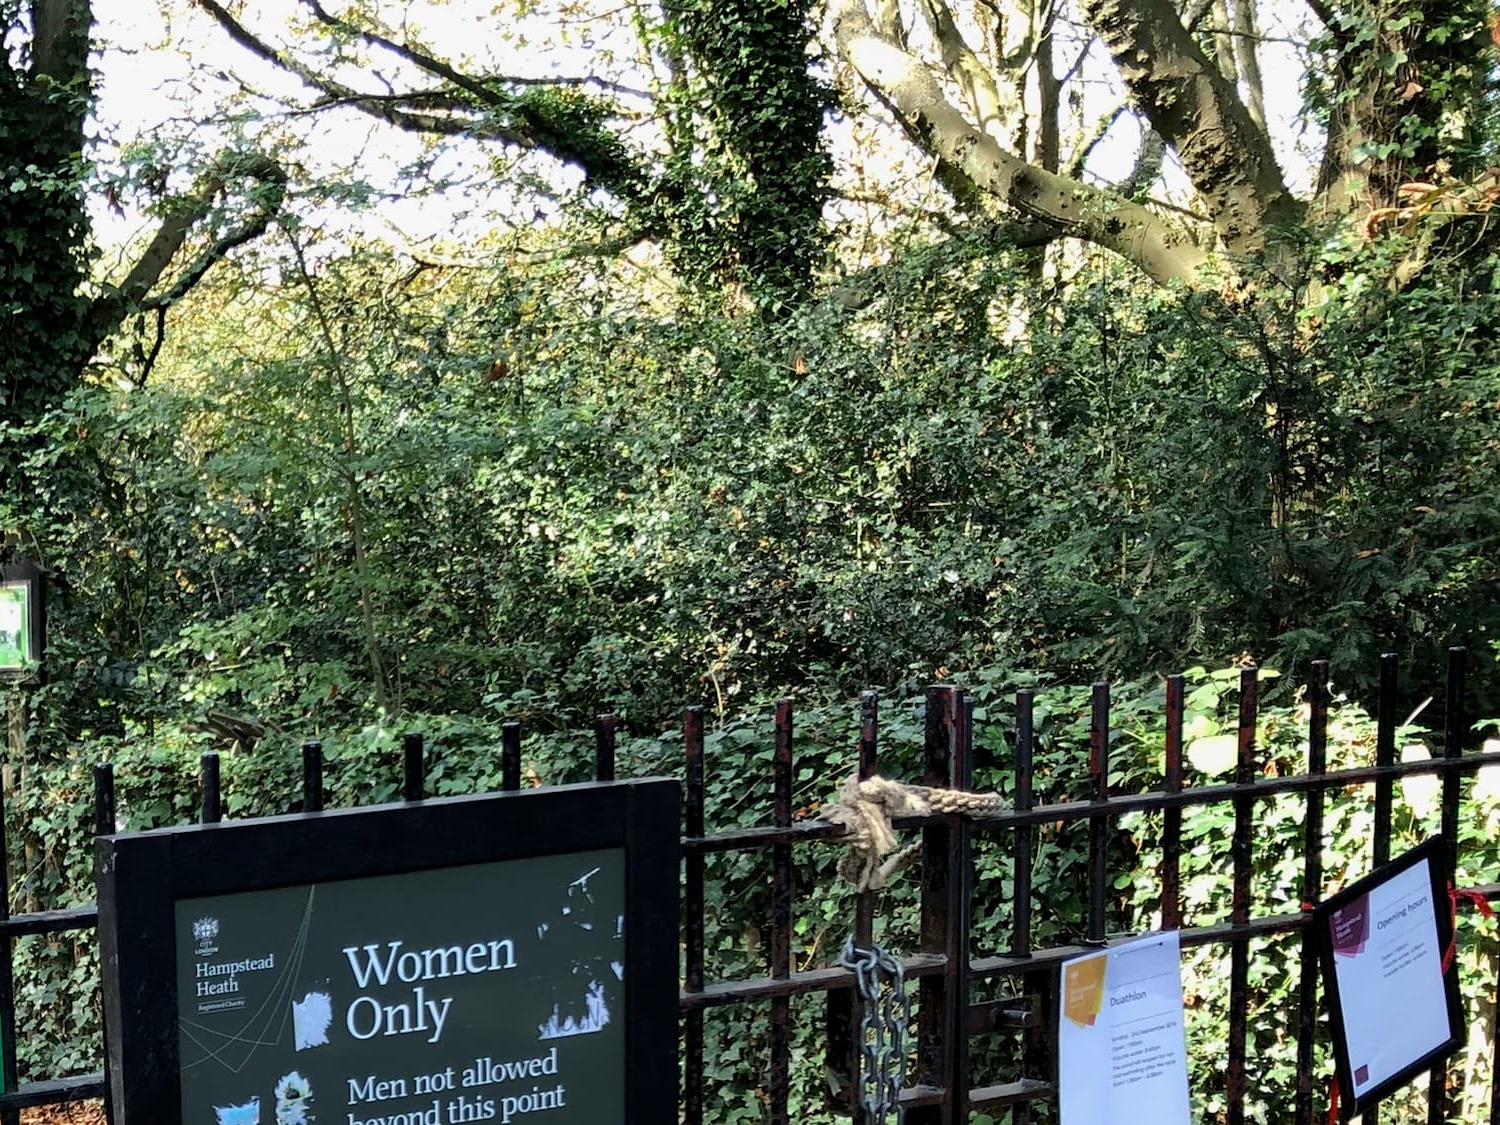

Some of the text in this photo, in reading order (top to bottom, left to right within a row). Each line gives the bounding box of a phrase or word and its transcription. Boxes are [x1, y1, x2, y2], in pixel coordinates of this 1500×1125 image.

[1377, 896, 1427, 930] Opening hours
[196, 953, 274, 977] Hampstead
[343, 937, 516, 989] Women
[196, 978, 239, 996] Heath
[1110, 991, 1147, 1007] Duathlon
[346, 987, 453, 1043] Only
[347, 1048, 558, 1105] Men not allowed
[447, 1094, 495, 1124] this
[501, 1085, 566, 1123] point
